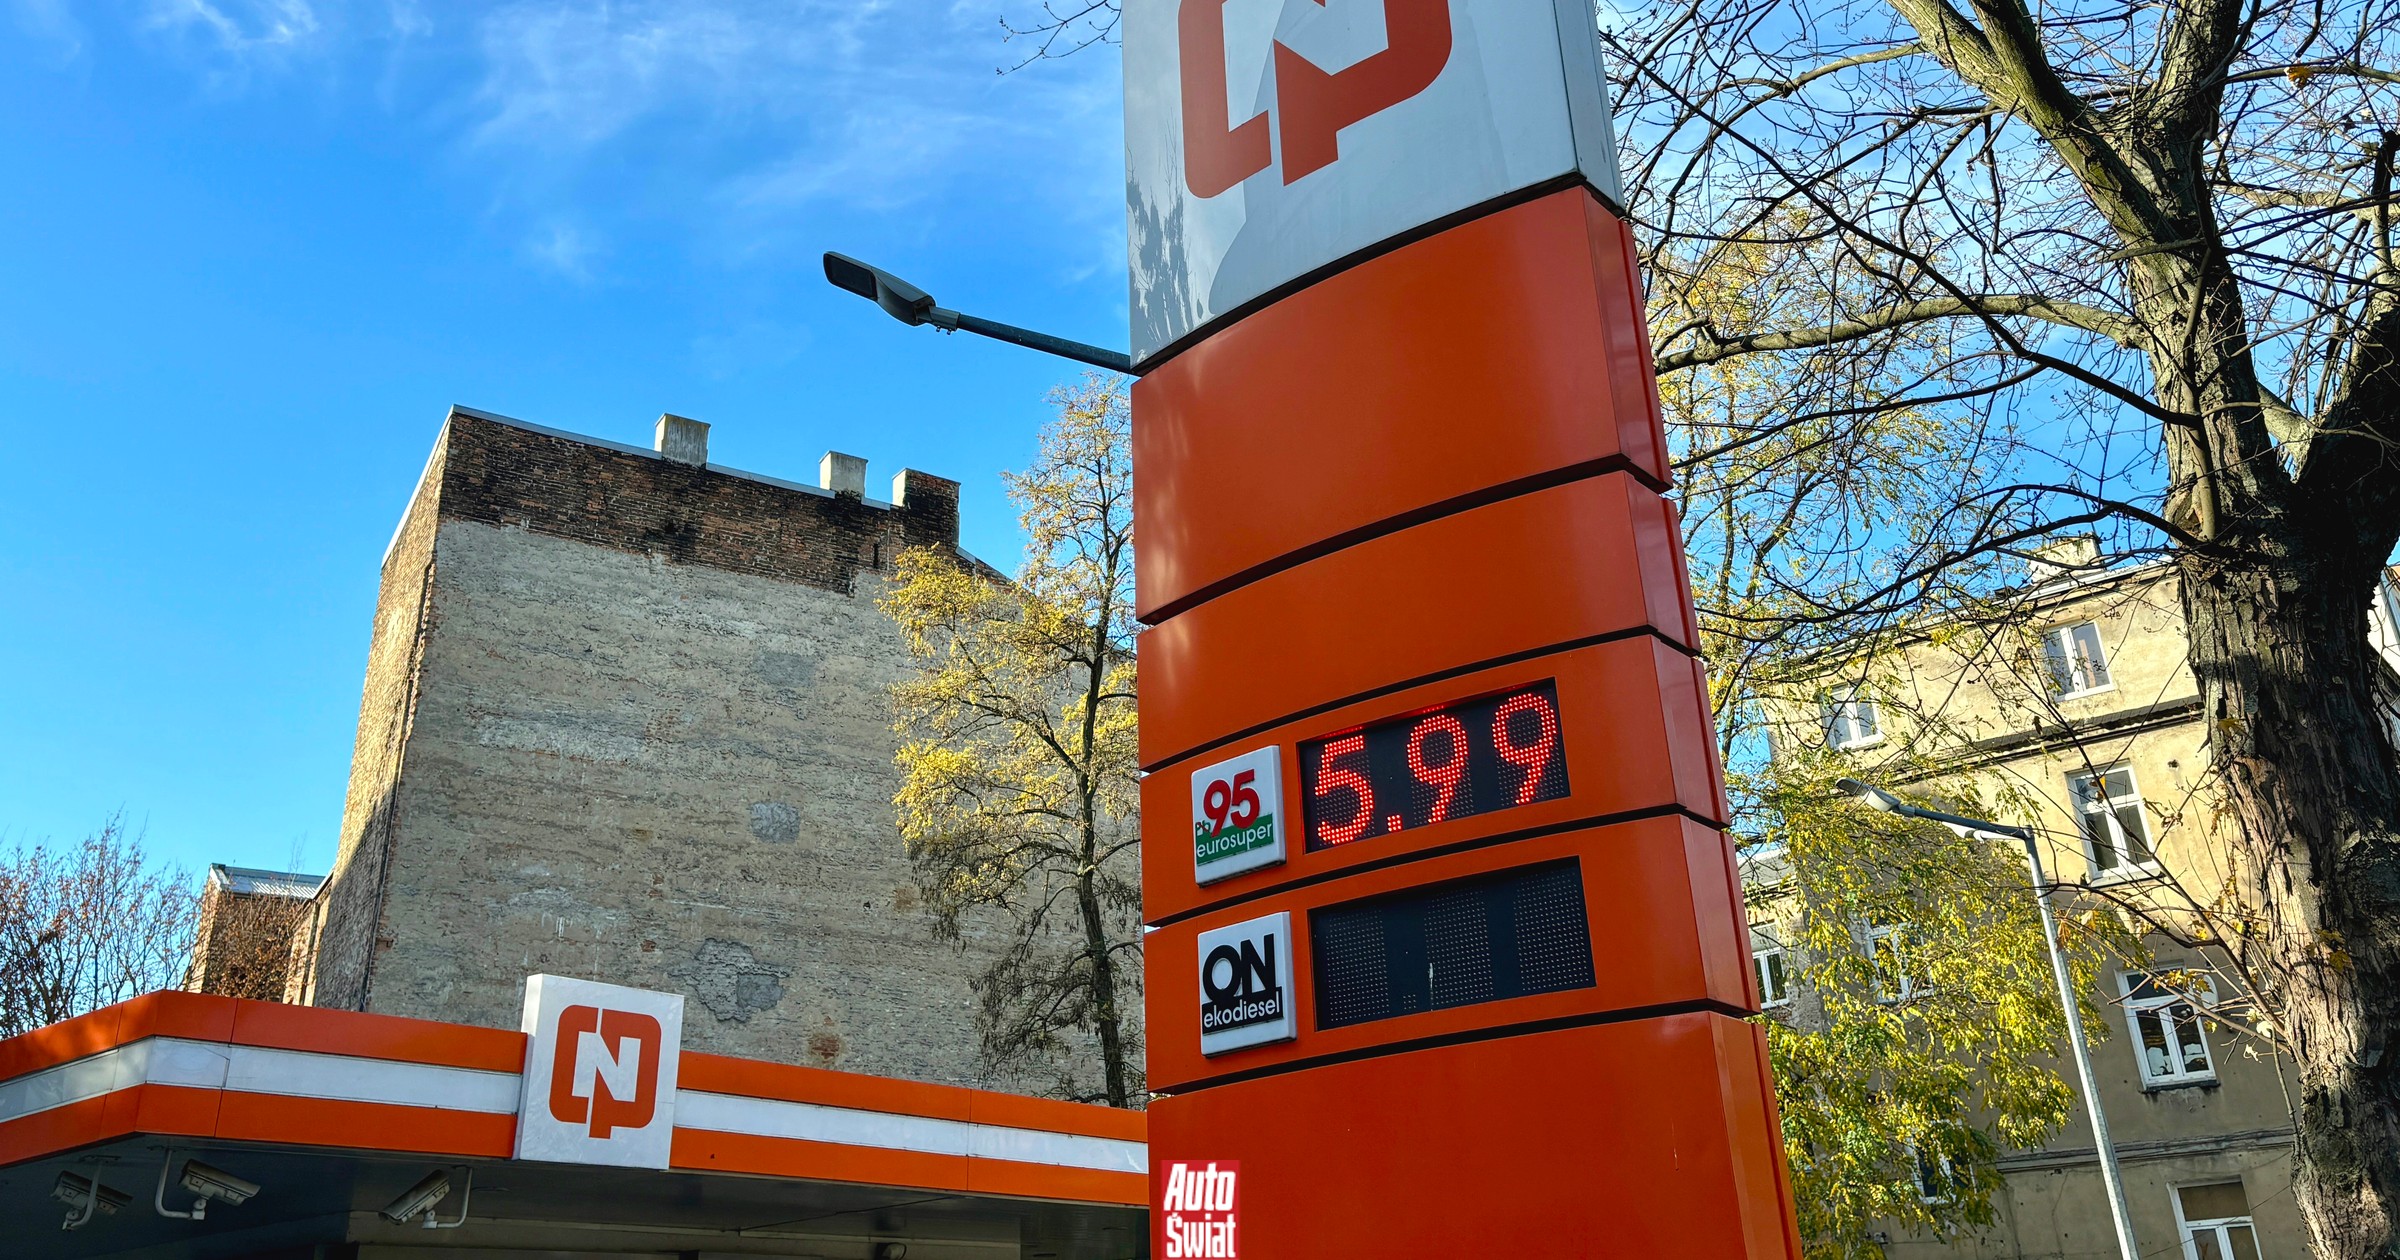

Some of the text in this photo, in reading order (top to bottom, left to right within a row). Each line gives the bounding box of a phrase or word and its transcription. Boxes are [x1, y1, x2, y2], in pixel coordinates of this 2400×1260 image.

[1203, 768, 1260, 838] 95
[1314, 692, 1558, 845] 5.99
[1196, 823, 1272, 858] eurosuper
[1202, 933, 1277, 1003] ON
[1203, 990, 1280, 1028] ekodiesel
